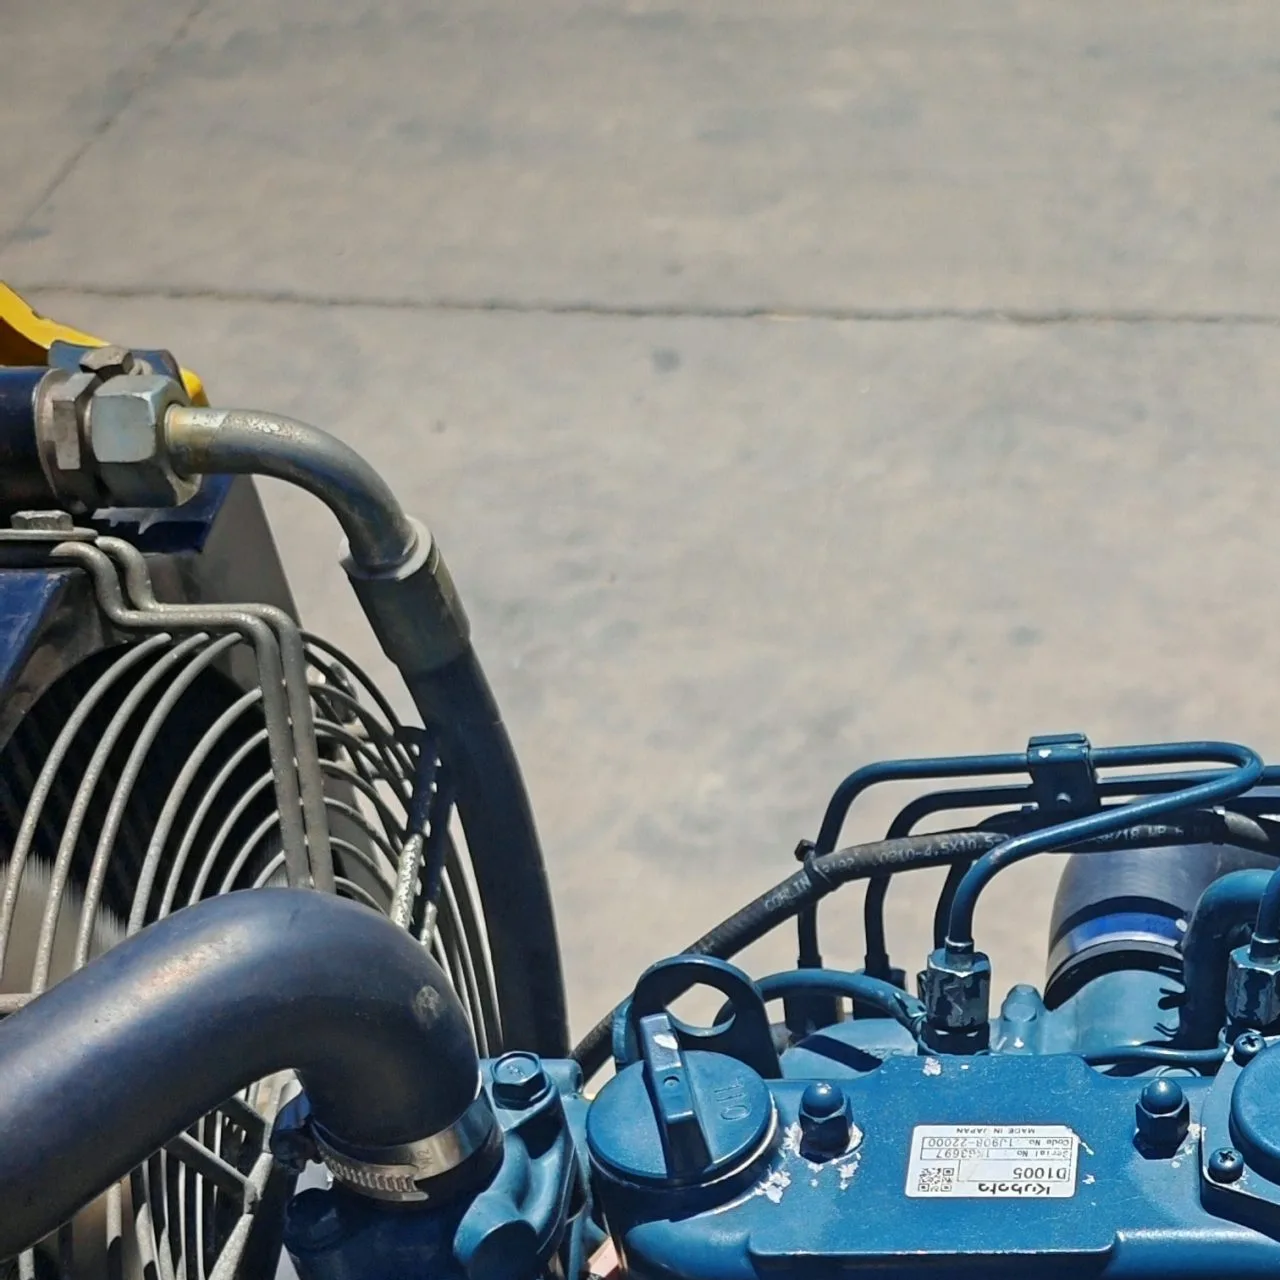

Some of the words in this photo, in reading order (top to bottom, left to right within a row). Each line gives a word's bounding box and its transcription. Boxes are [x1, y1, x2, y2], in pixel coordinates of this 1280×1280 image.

[714, 1078, 751, 1120] OIL
[1013, 1168, 1067, 1180] D1005
[978, 1183, 1050, 1195] Kubota
